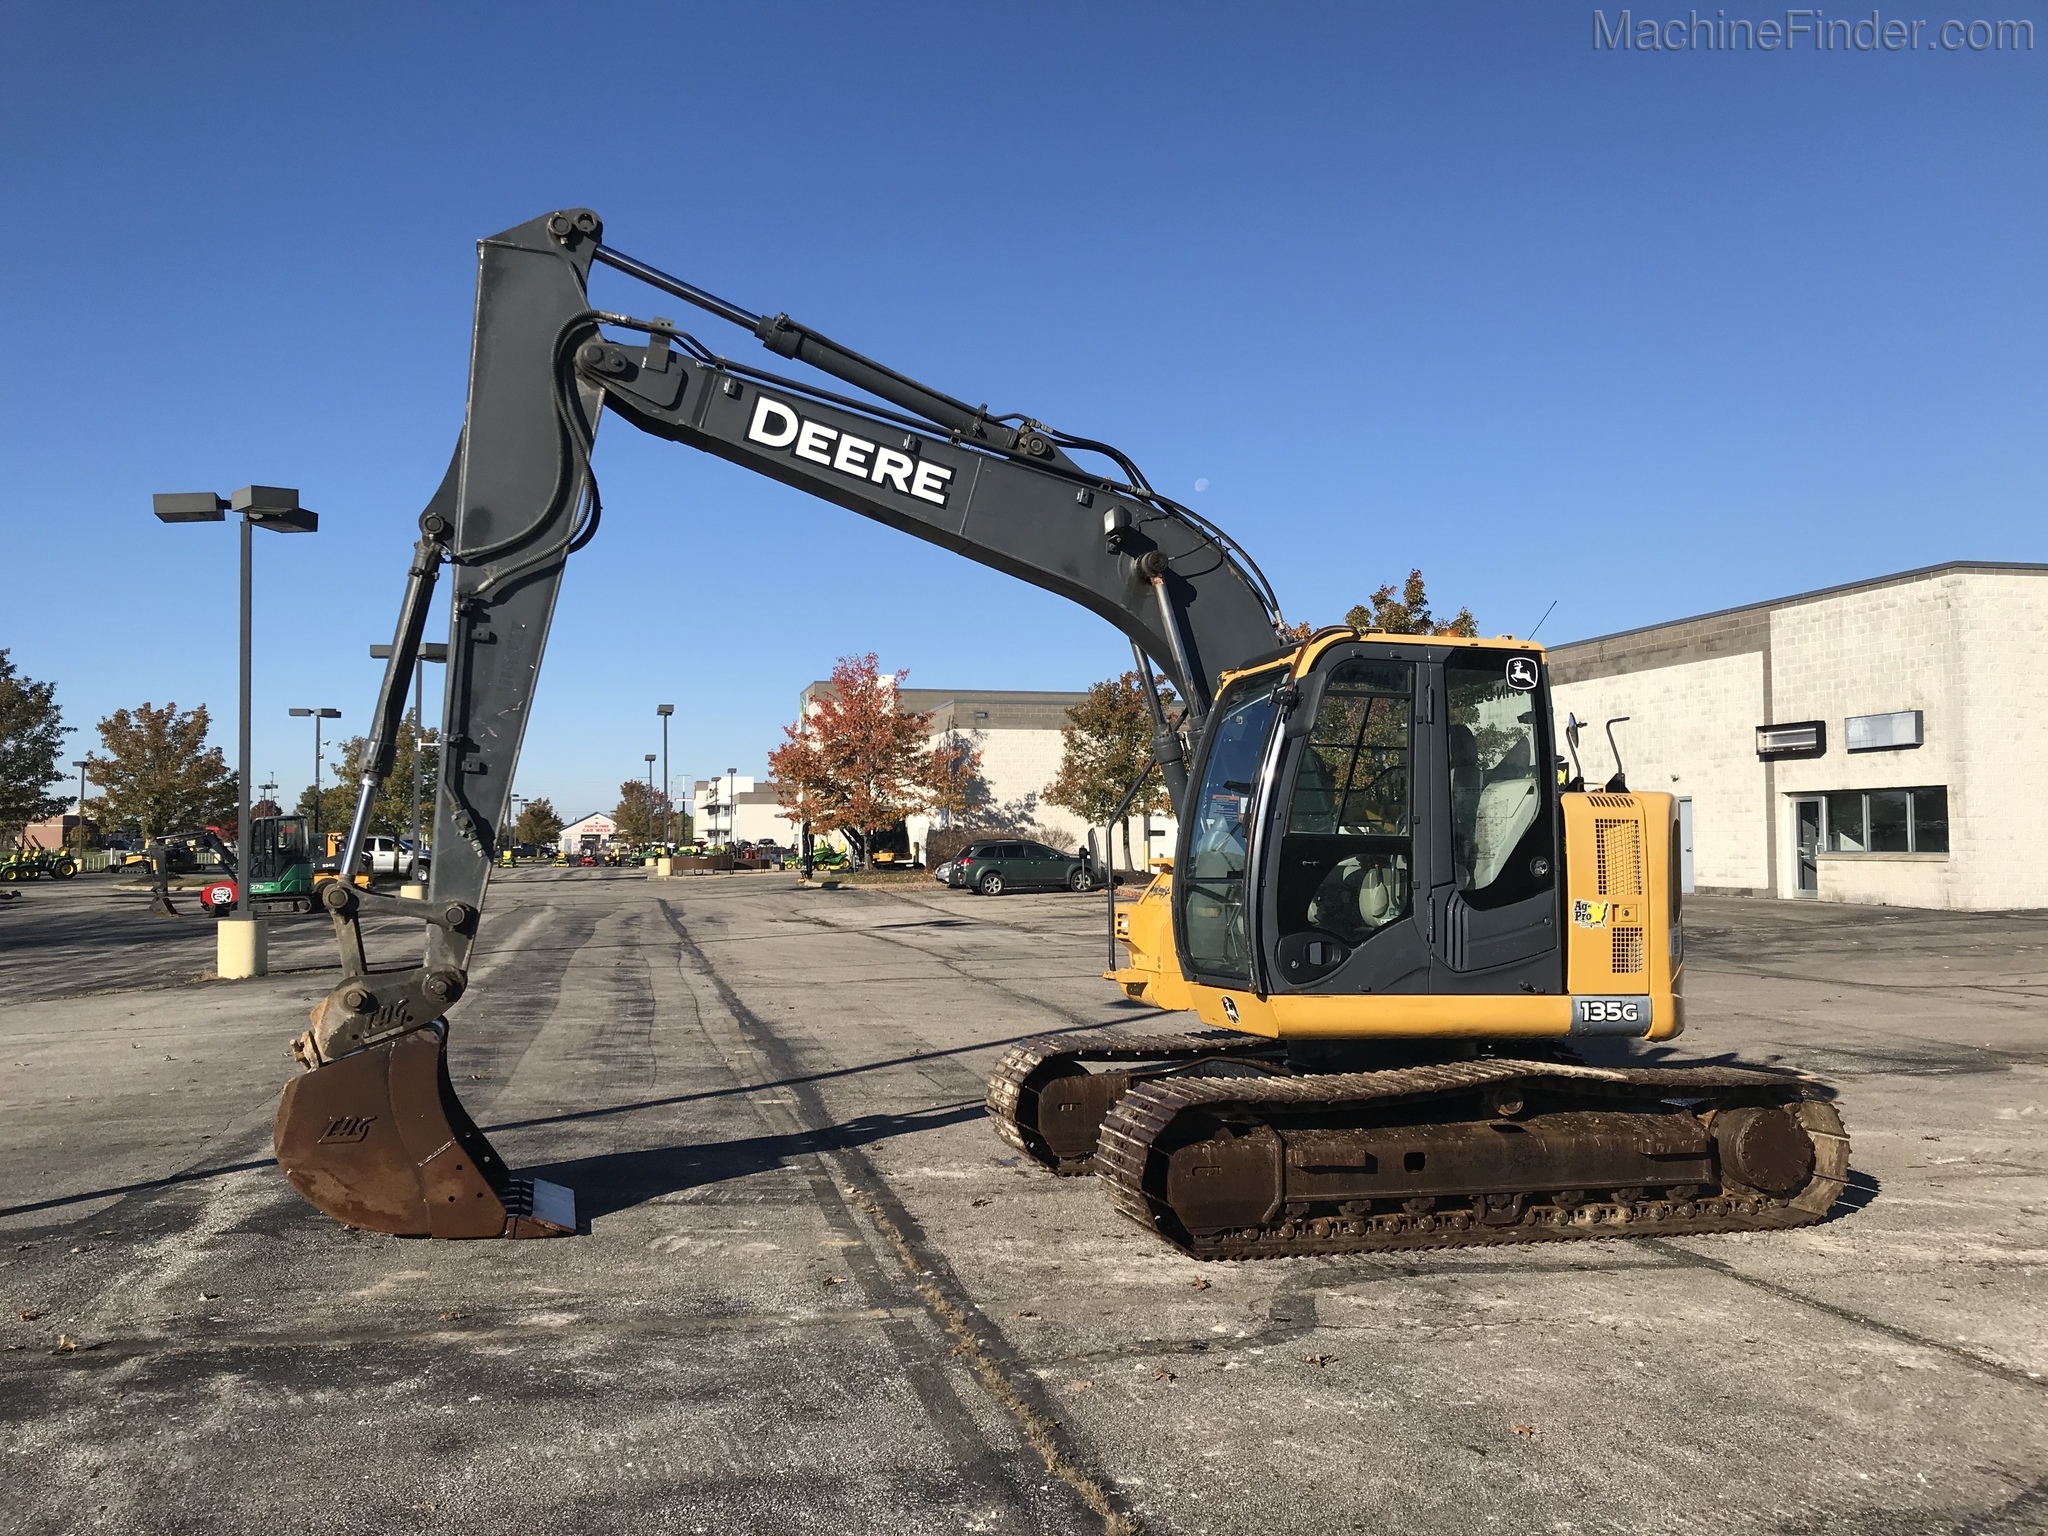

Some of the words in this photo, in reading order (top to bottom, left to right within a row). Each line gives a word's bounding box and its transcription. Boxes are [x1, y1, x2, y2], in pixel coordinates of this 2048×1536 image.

[748, 396, 952, 505] DEERE
[1574, 901, 1592, 912] Ag-
[1575, 911, 1592, 921] Pro
[1580, 1001, 1638, 1022] 135G
